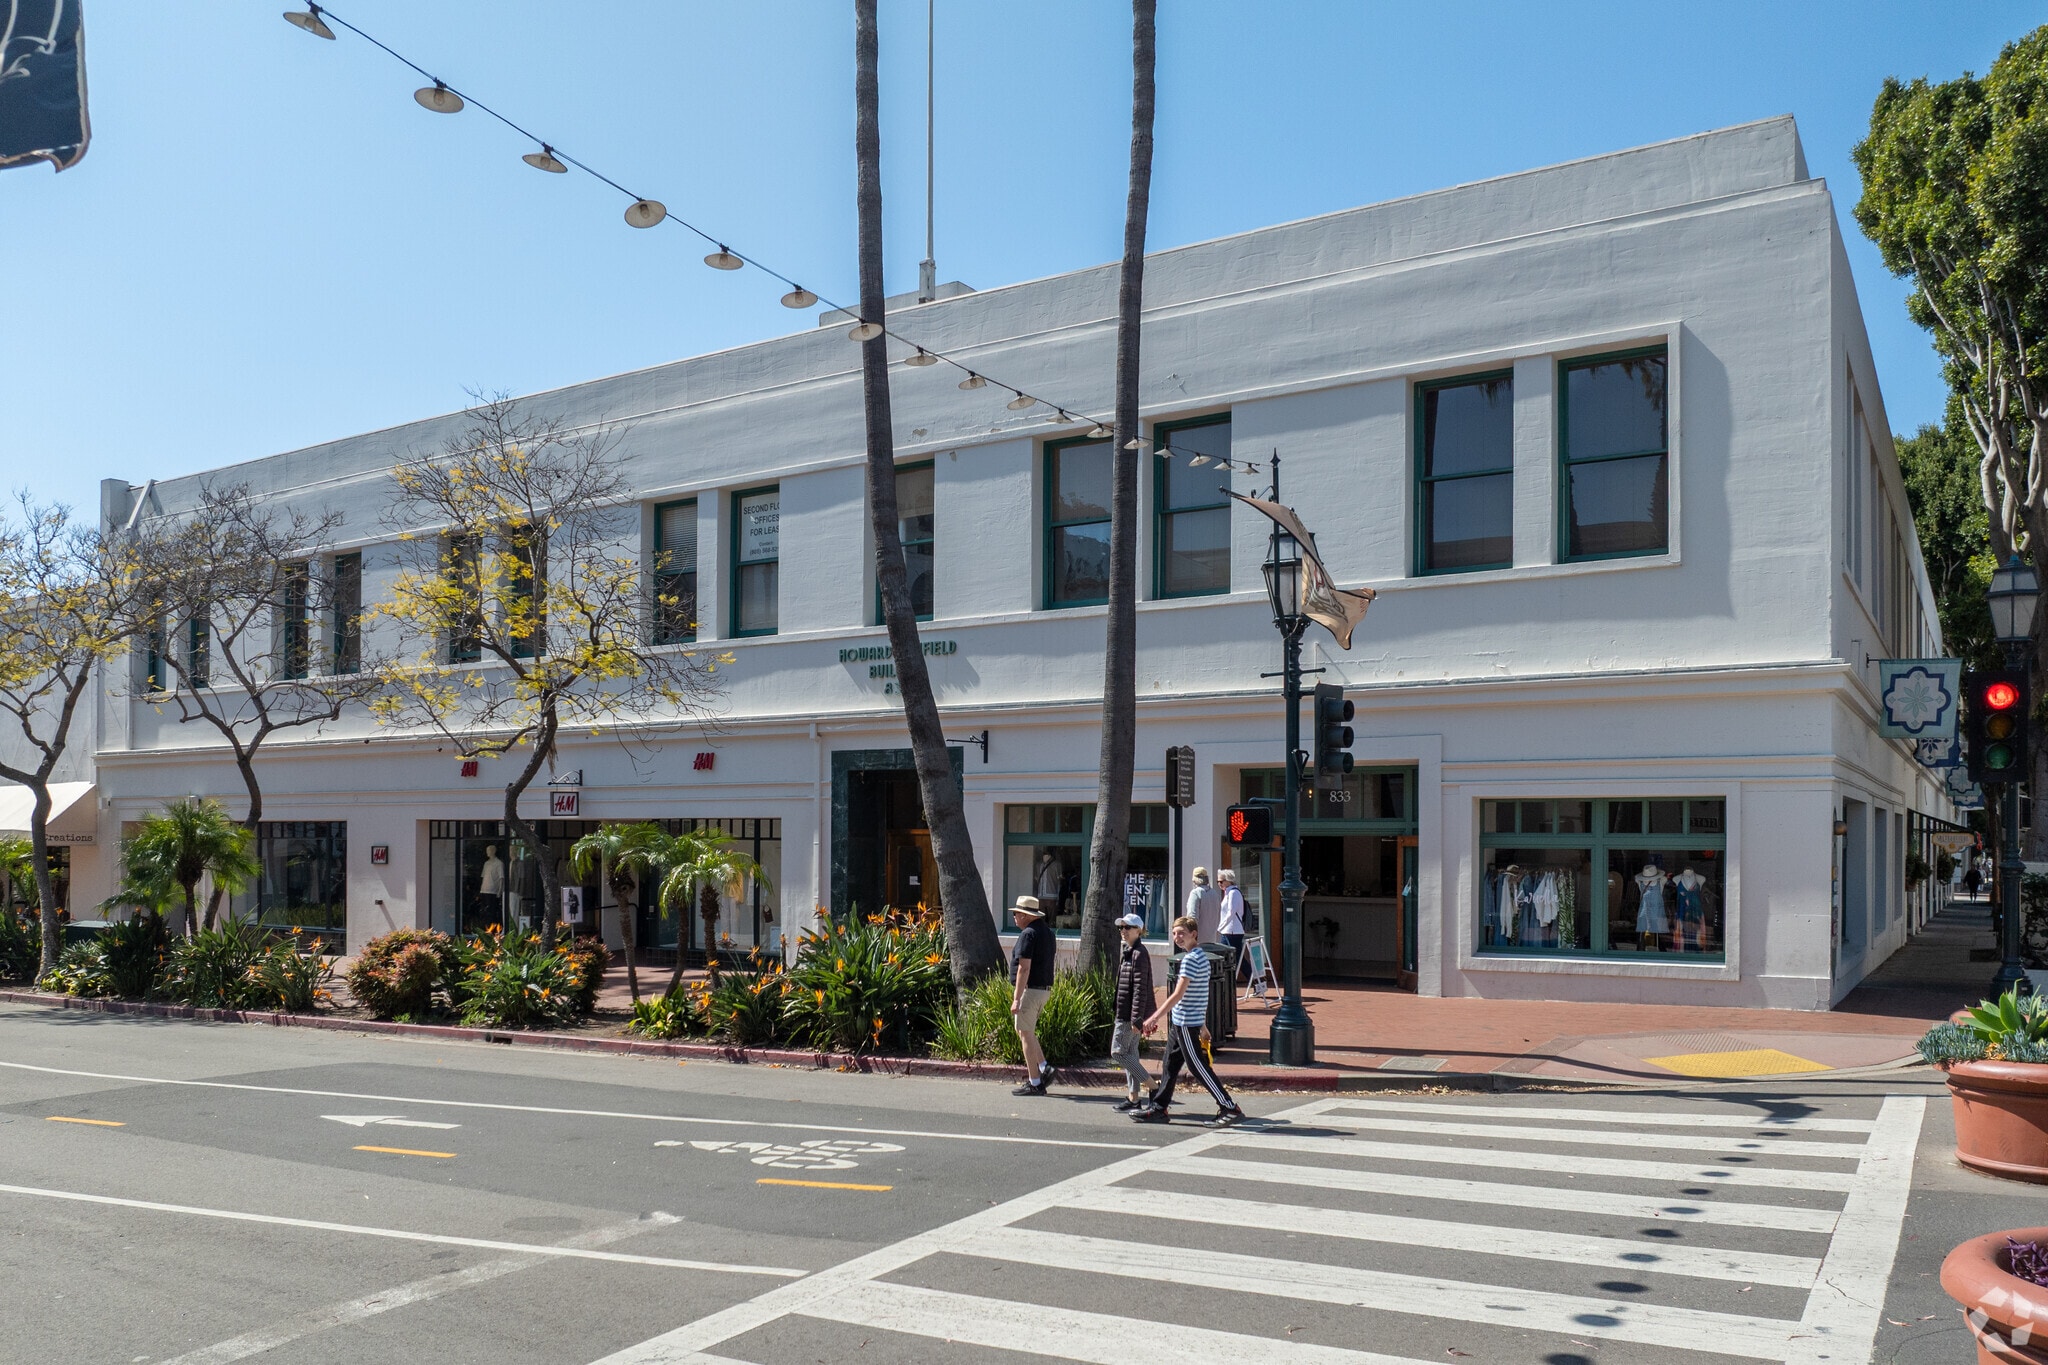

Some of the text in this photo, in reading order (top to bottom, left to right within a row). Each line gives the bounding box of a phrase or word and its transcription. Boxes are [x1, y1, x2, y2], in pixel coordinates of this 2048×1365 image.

[743, 504, 768, 515] SECOND
[754, 514, 779, 525] OFFICES
[750, 528, 763, 536] FOR
[839, 640, 957, 662] HOWARD FIELD
[693, 752, 715, 770] H&M
[1330, 791, 1351, 802] 833
[555, 795, 576, 812] H&M
[1125, 884, 1151, 895] EN'S
